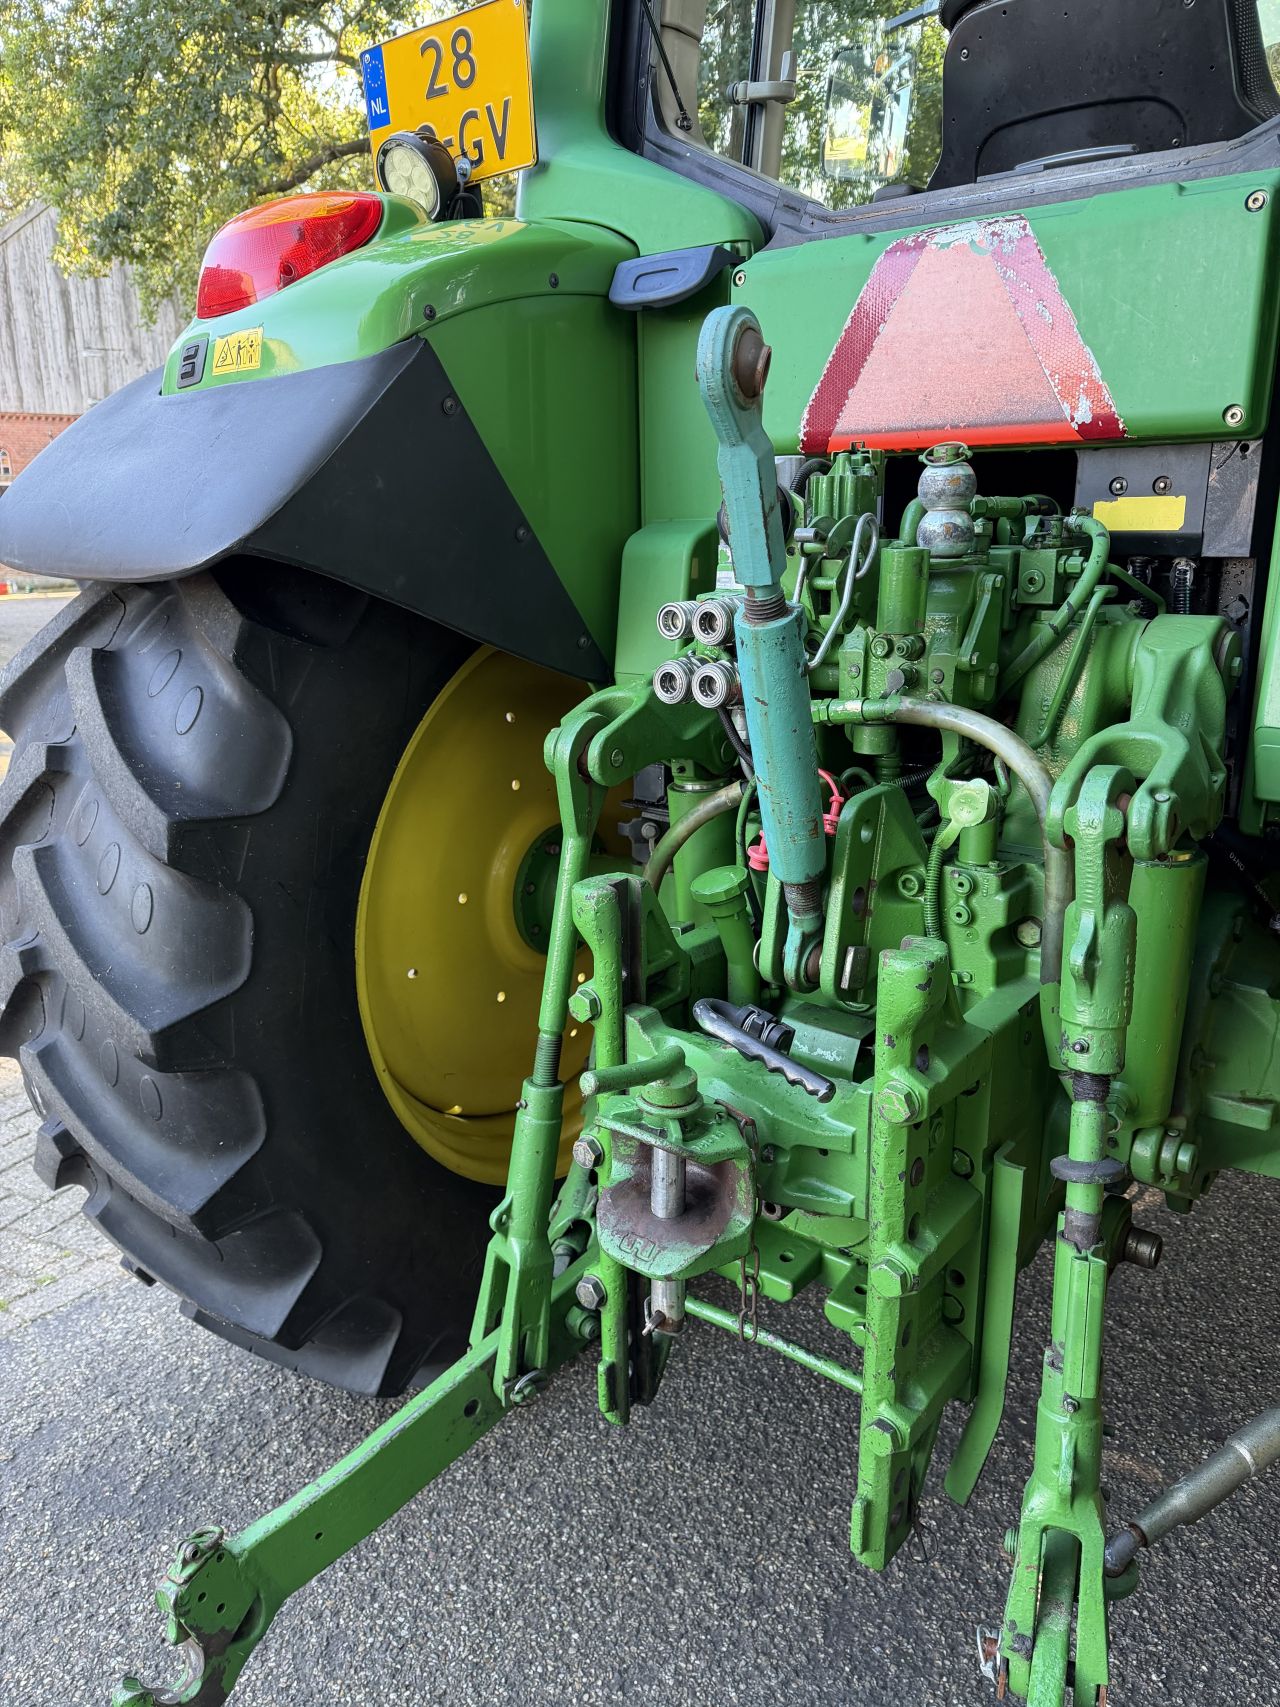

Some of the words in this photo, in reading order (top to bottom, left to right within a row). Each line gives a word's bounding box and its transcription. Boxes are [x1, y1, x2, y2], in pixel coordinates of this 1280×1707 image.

[420, 27, 476, 100] 28
[370, 97, 387, 117] NL
[416, 97, 512, 170] -GV
